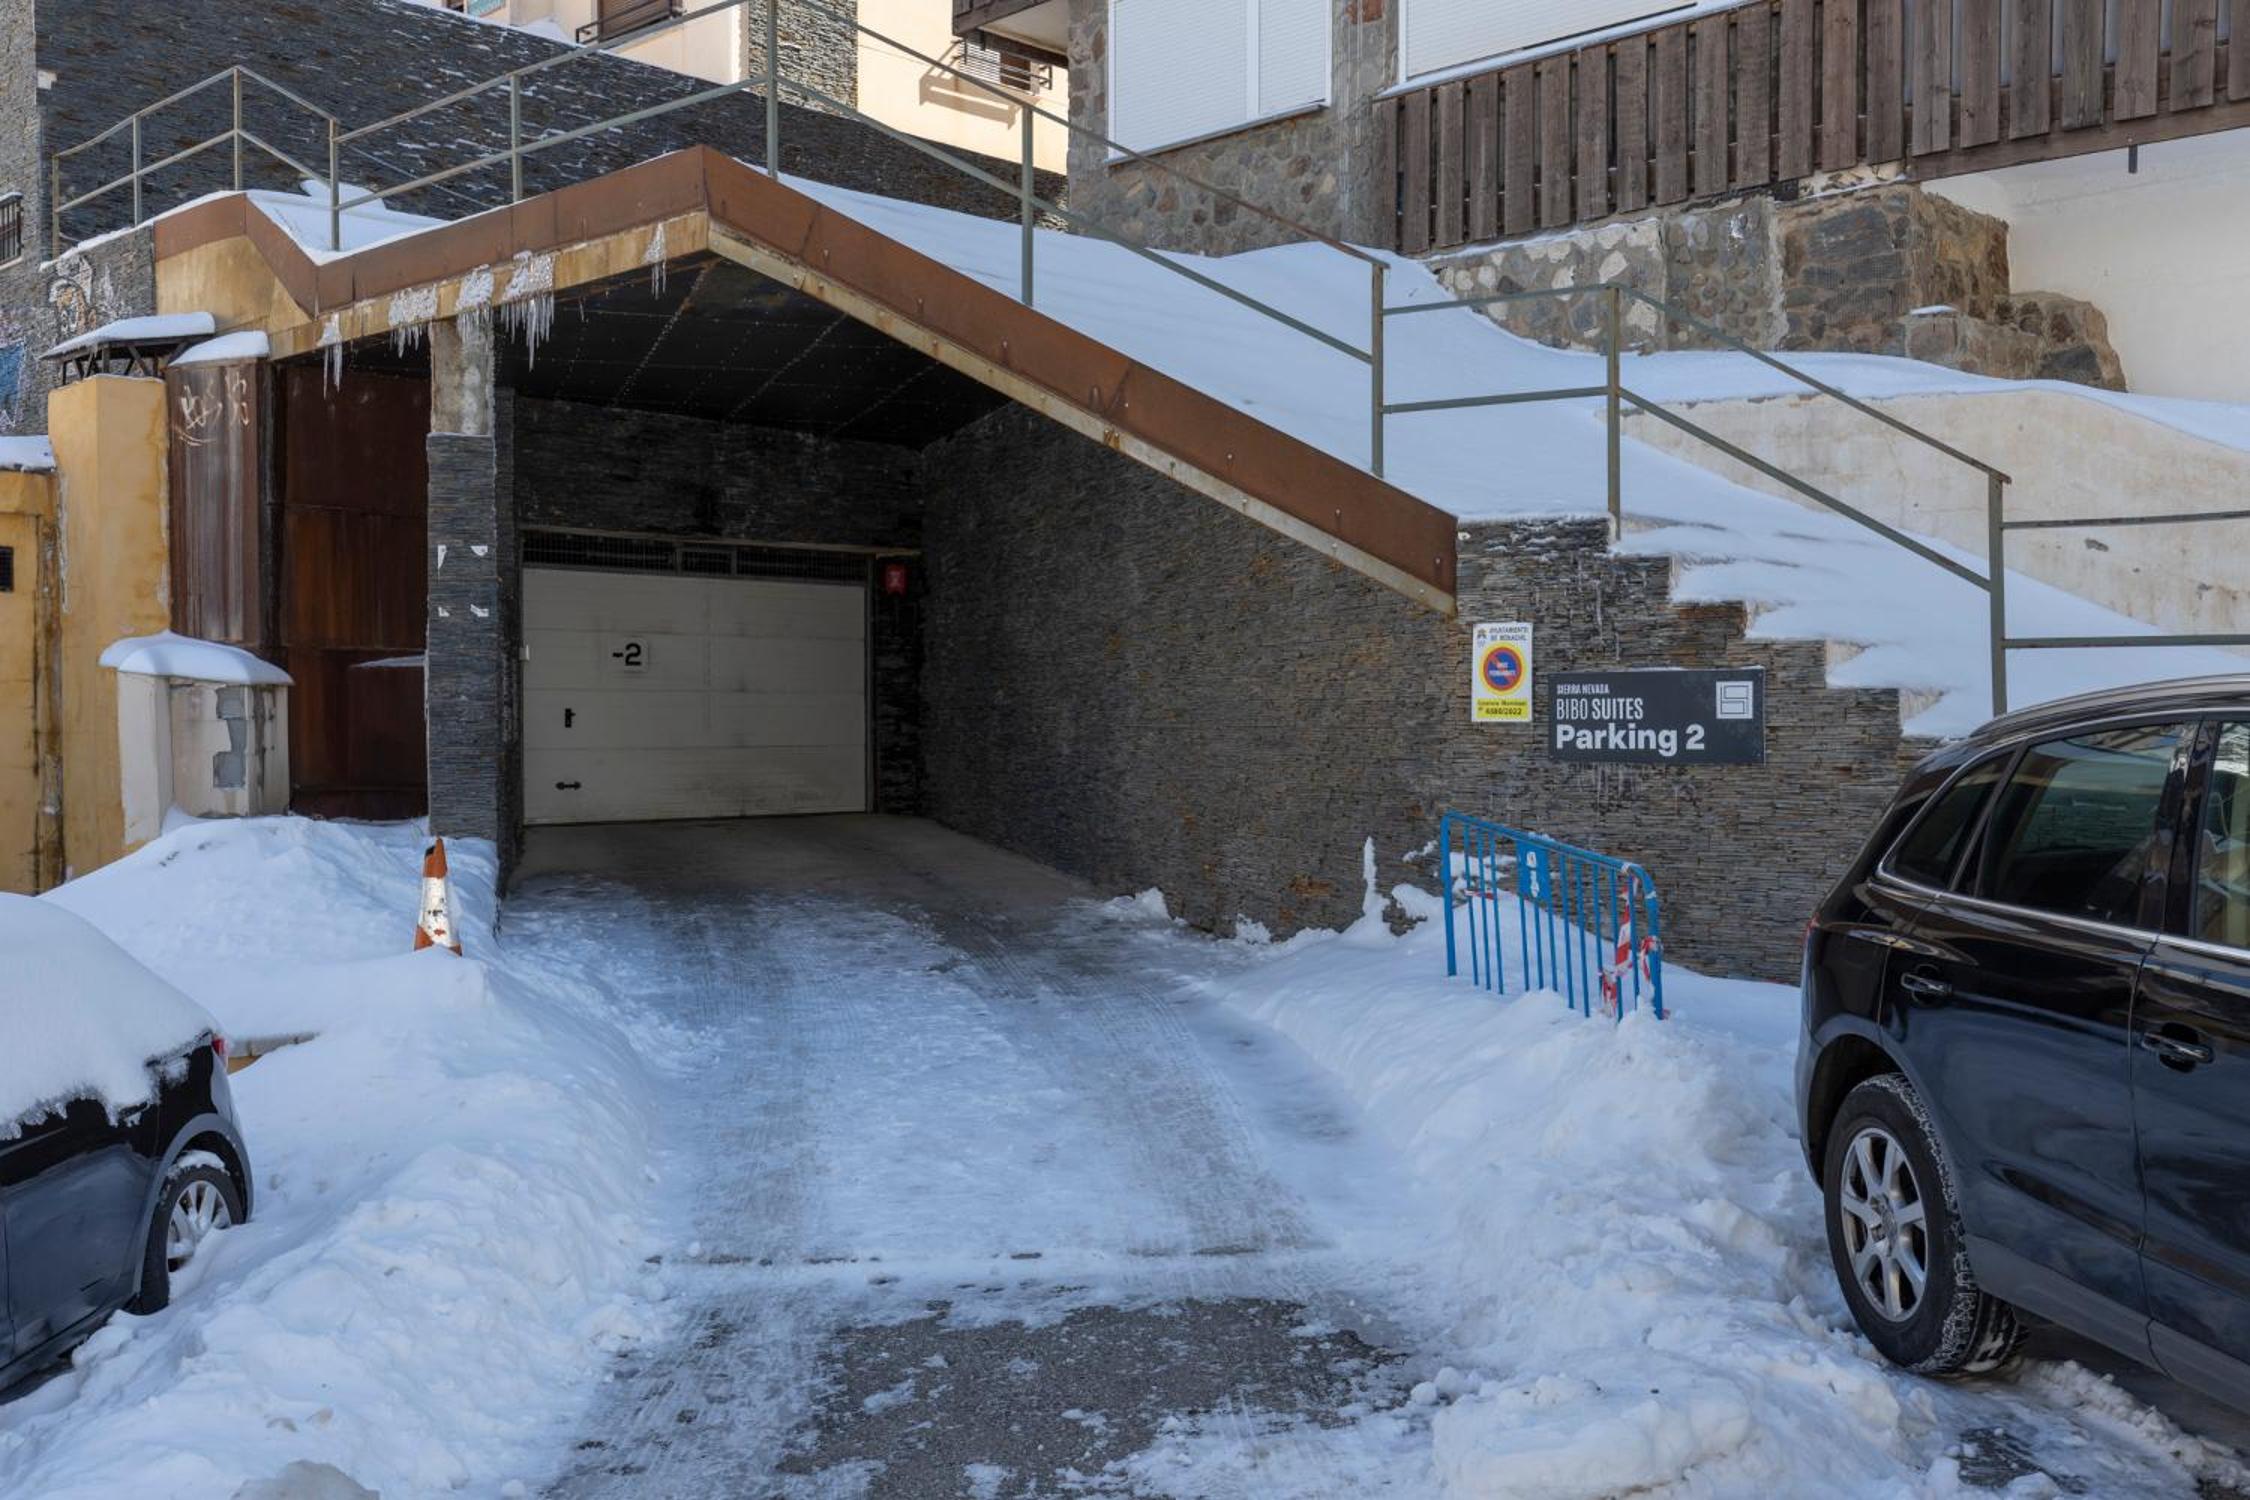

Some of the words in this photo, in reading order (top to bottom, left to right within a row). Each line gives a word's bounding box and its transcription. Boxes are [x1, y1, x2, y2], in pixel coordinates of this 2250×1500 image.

[612, 642, 642, 666] -2
[1557, 684, 1581, 695] SIERRA
[1582, 684, 1610, 694] NEVADA
[1556, 698, 1588, 720] BIBO
[1591, 697, 1644, 720] SUITES
[1556, 723, 1678, 757] Parking
[1685, 724, 1705, 750] 2
